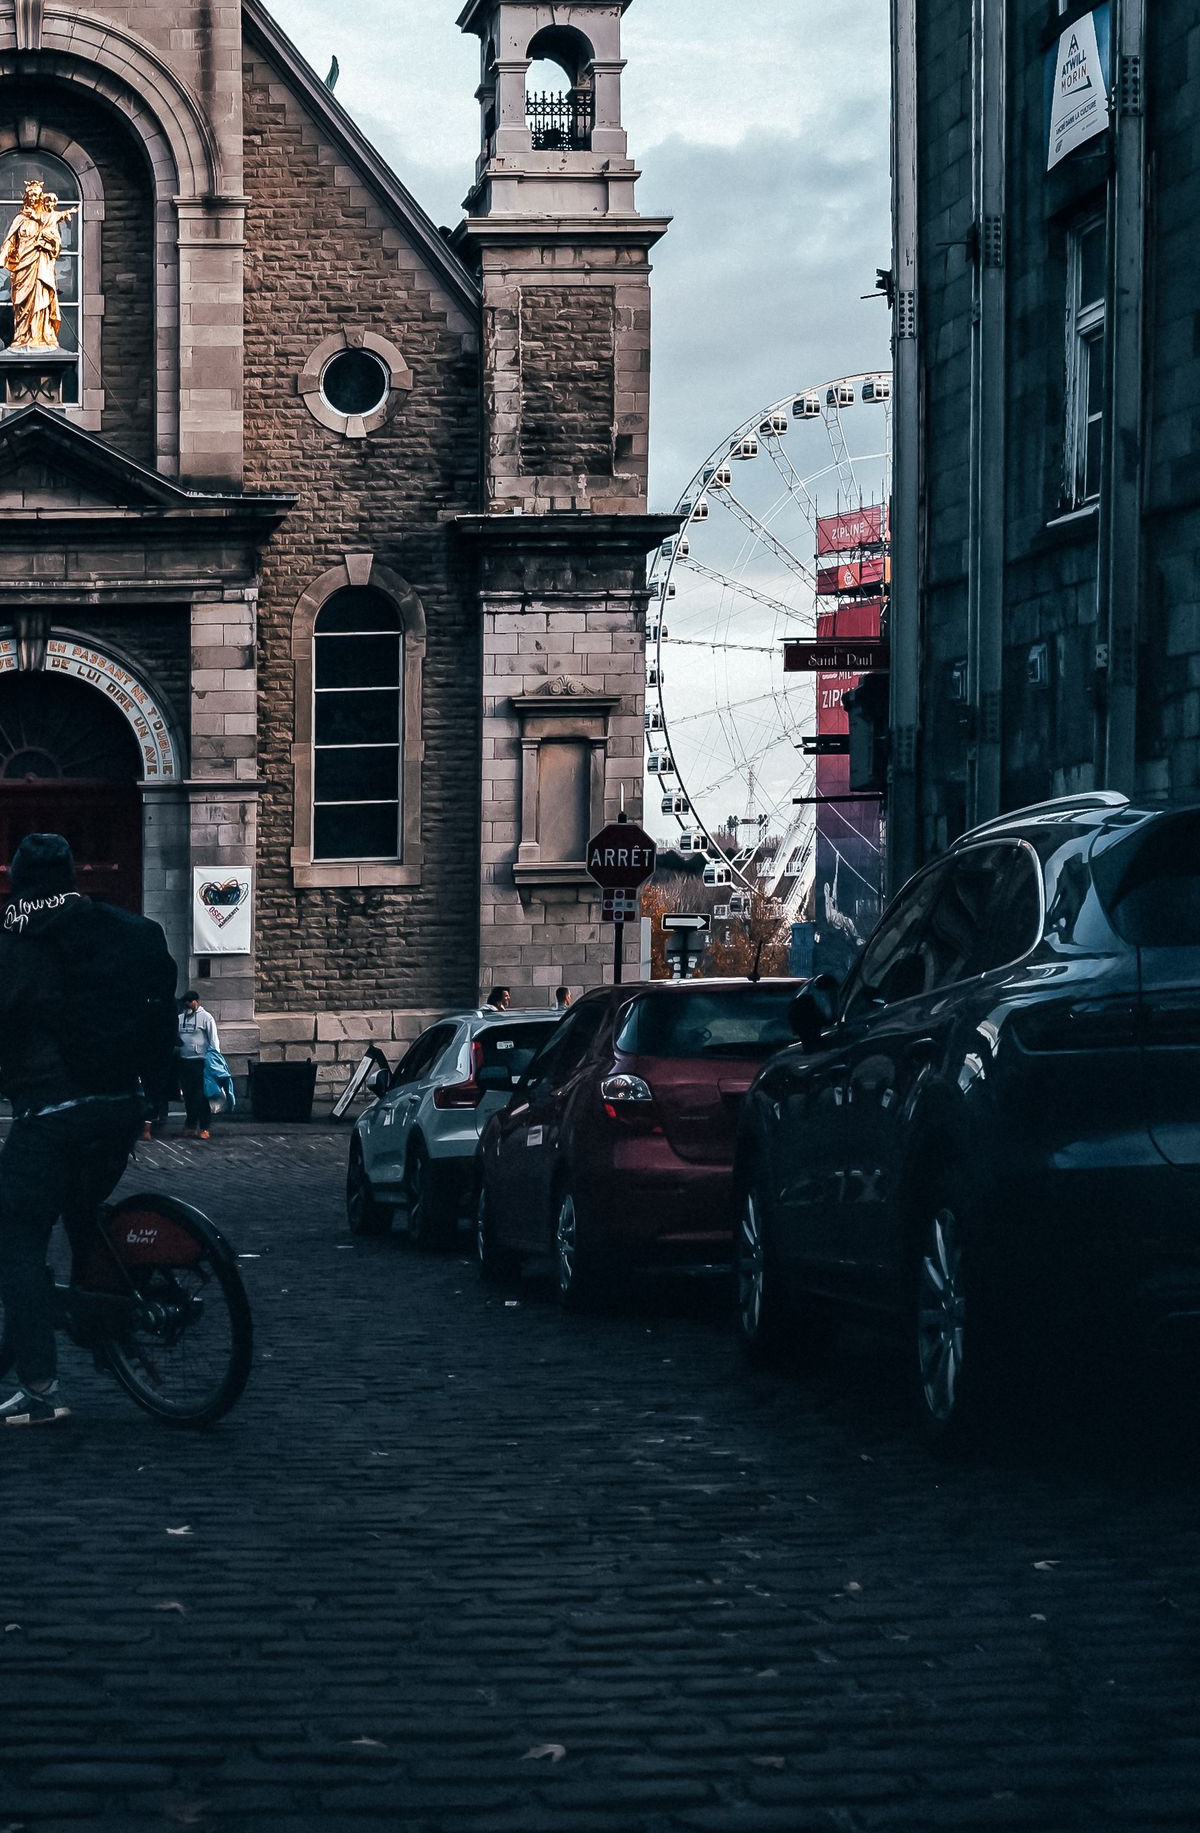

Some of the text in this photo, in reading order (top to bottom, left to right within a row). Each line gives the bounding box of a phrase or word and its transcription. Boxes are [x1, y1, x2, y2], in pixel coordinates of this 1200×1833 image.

[1062, 49, 1086, 78] ATWILL
[1061, 63, 1087, 94] MORIN
[831, 522, 865, 540] ZIPLINE
[808, 653, 872, 666] Saint Paul
[49, 641, 67, 653] EN
[72, 646, 133, 685] PASSANT
[131, 684, 149, 705] NE
[51, 657, 158, 775] DE LUI DIRE UN AVE
[590, 844, 652, 867] ARRÊT
[208, 906, 225, 922] OSEZ
